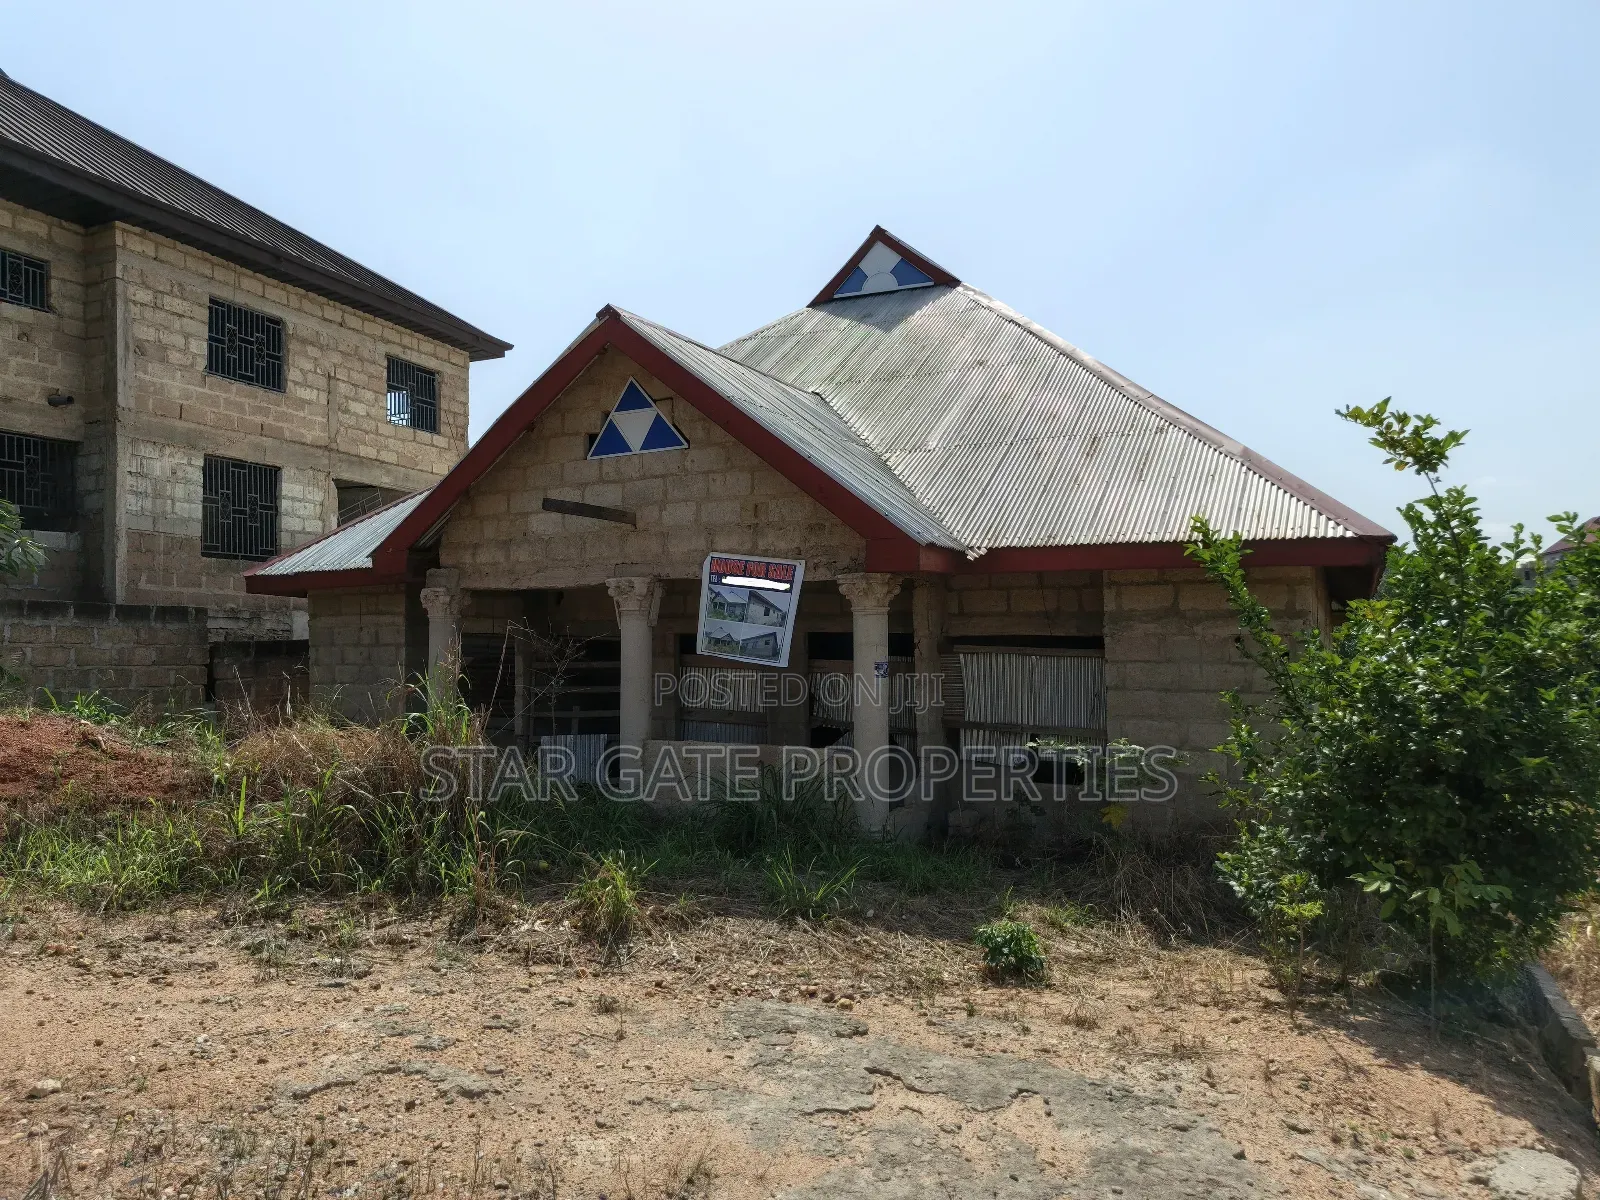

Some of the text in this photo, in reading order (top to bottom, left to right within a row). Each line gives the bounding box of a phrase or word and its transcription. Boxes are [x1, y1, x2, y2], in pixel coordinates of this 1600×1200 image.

[710, 558, 794, 580] HOUSE FOR SALE
